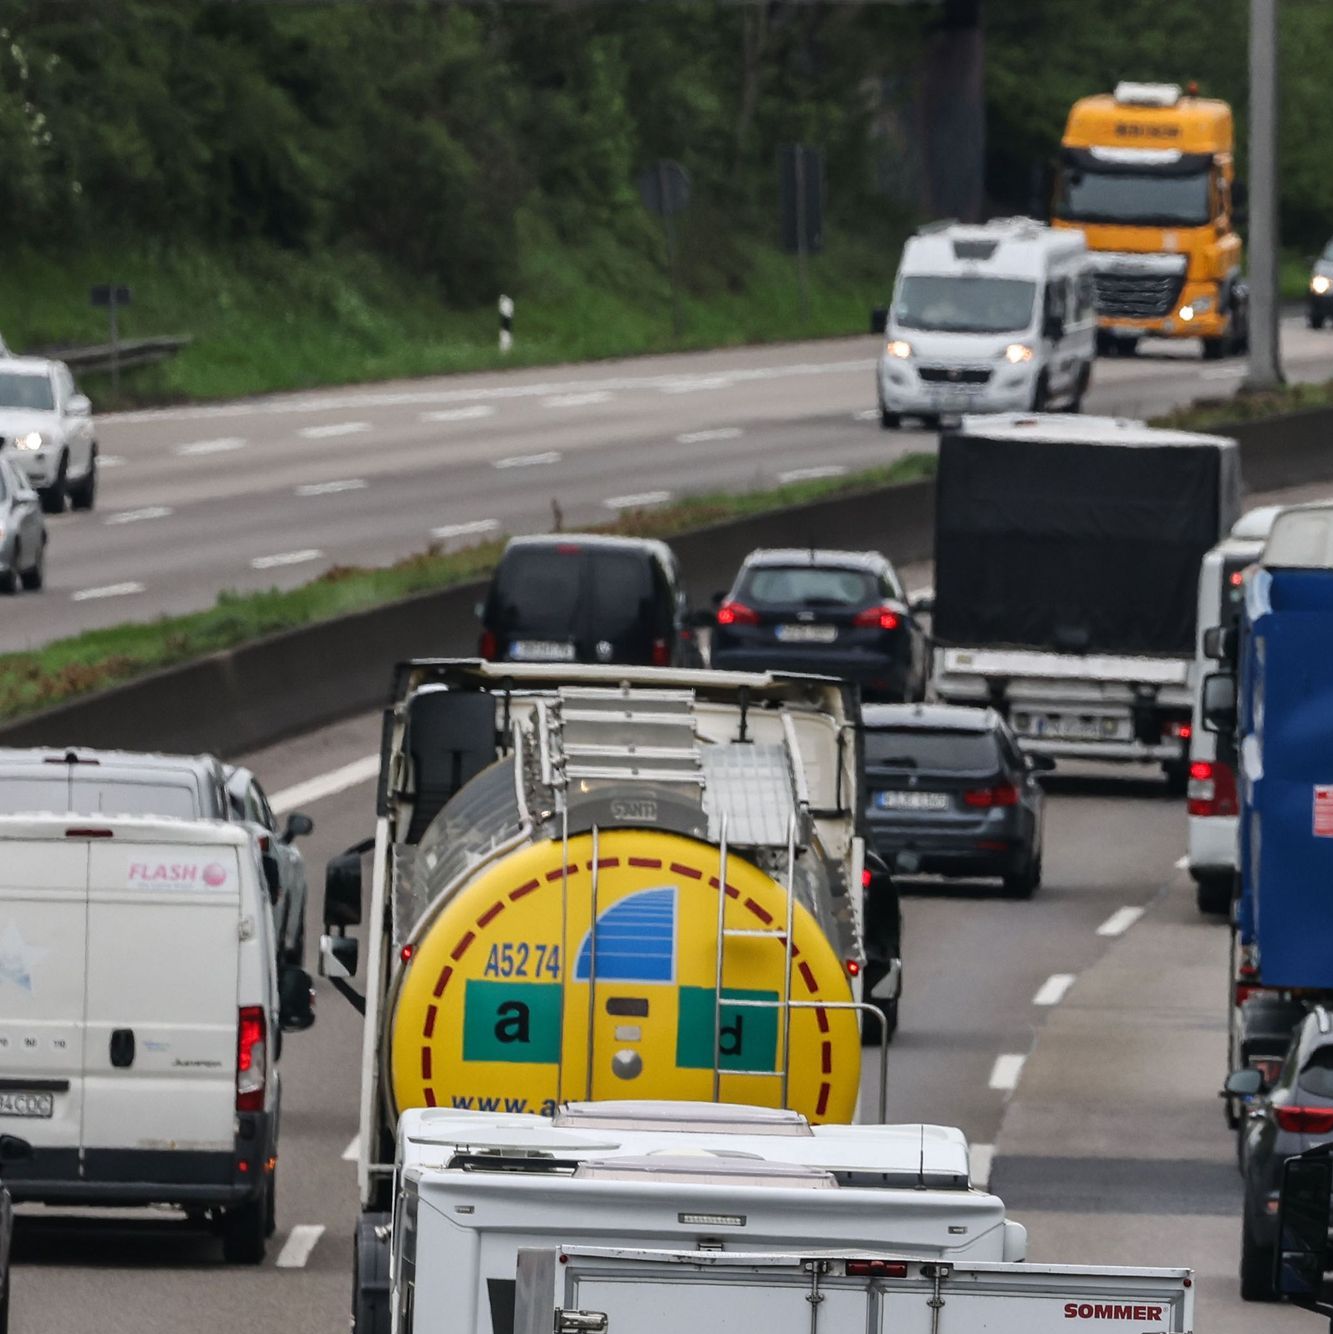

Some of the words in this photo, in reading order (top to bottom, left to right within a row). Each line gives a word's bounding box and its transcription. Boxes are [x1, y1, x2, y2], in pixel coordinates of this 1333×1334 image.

[128, 863, 197, 881] FLASH
[493, 1000, 530, 1044] a
[718, 1016, 743, 1056] d
[1064, 1303, 1162, 1321] SOMMER
